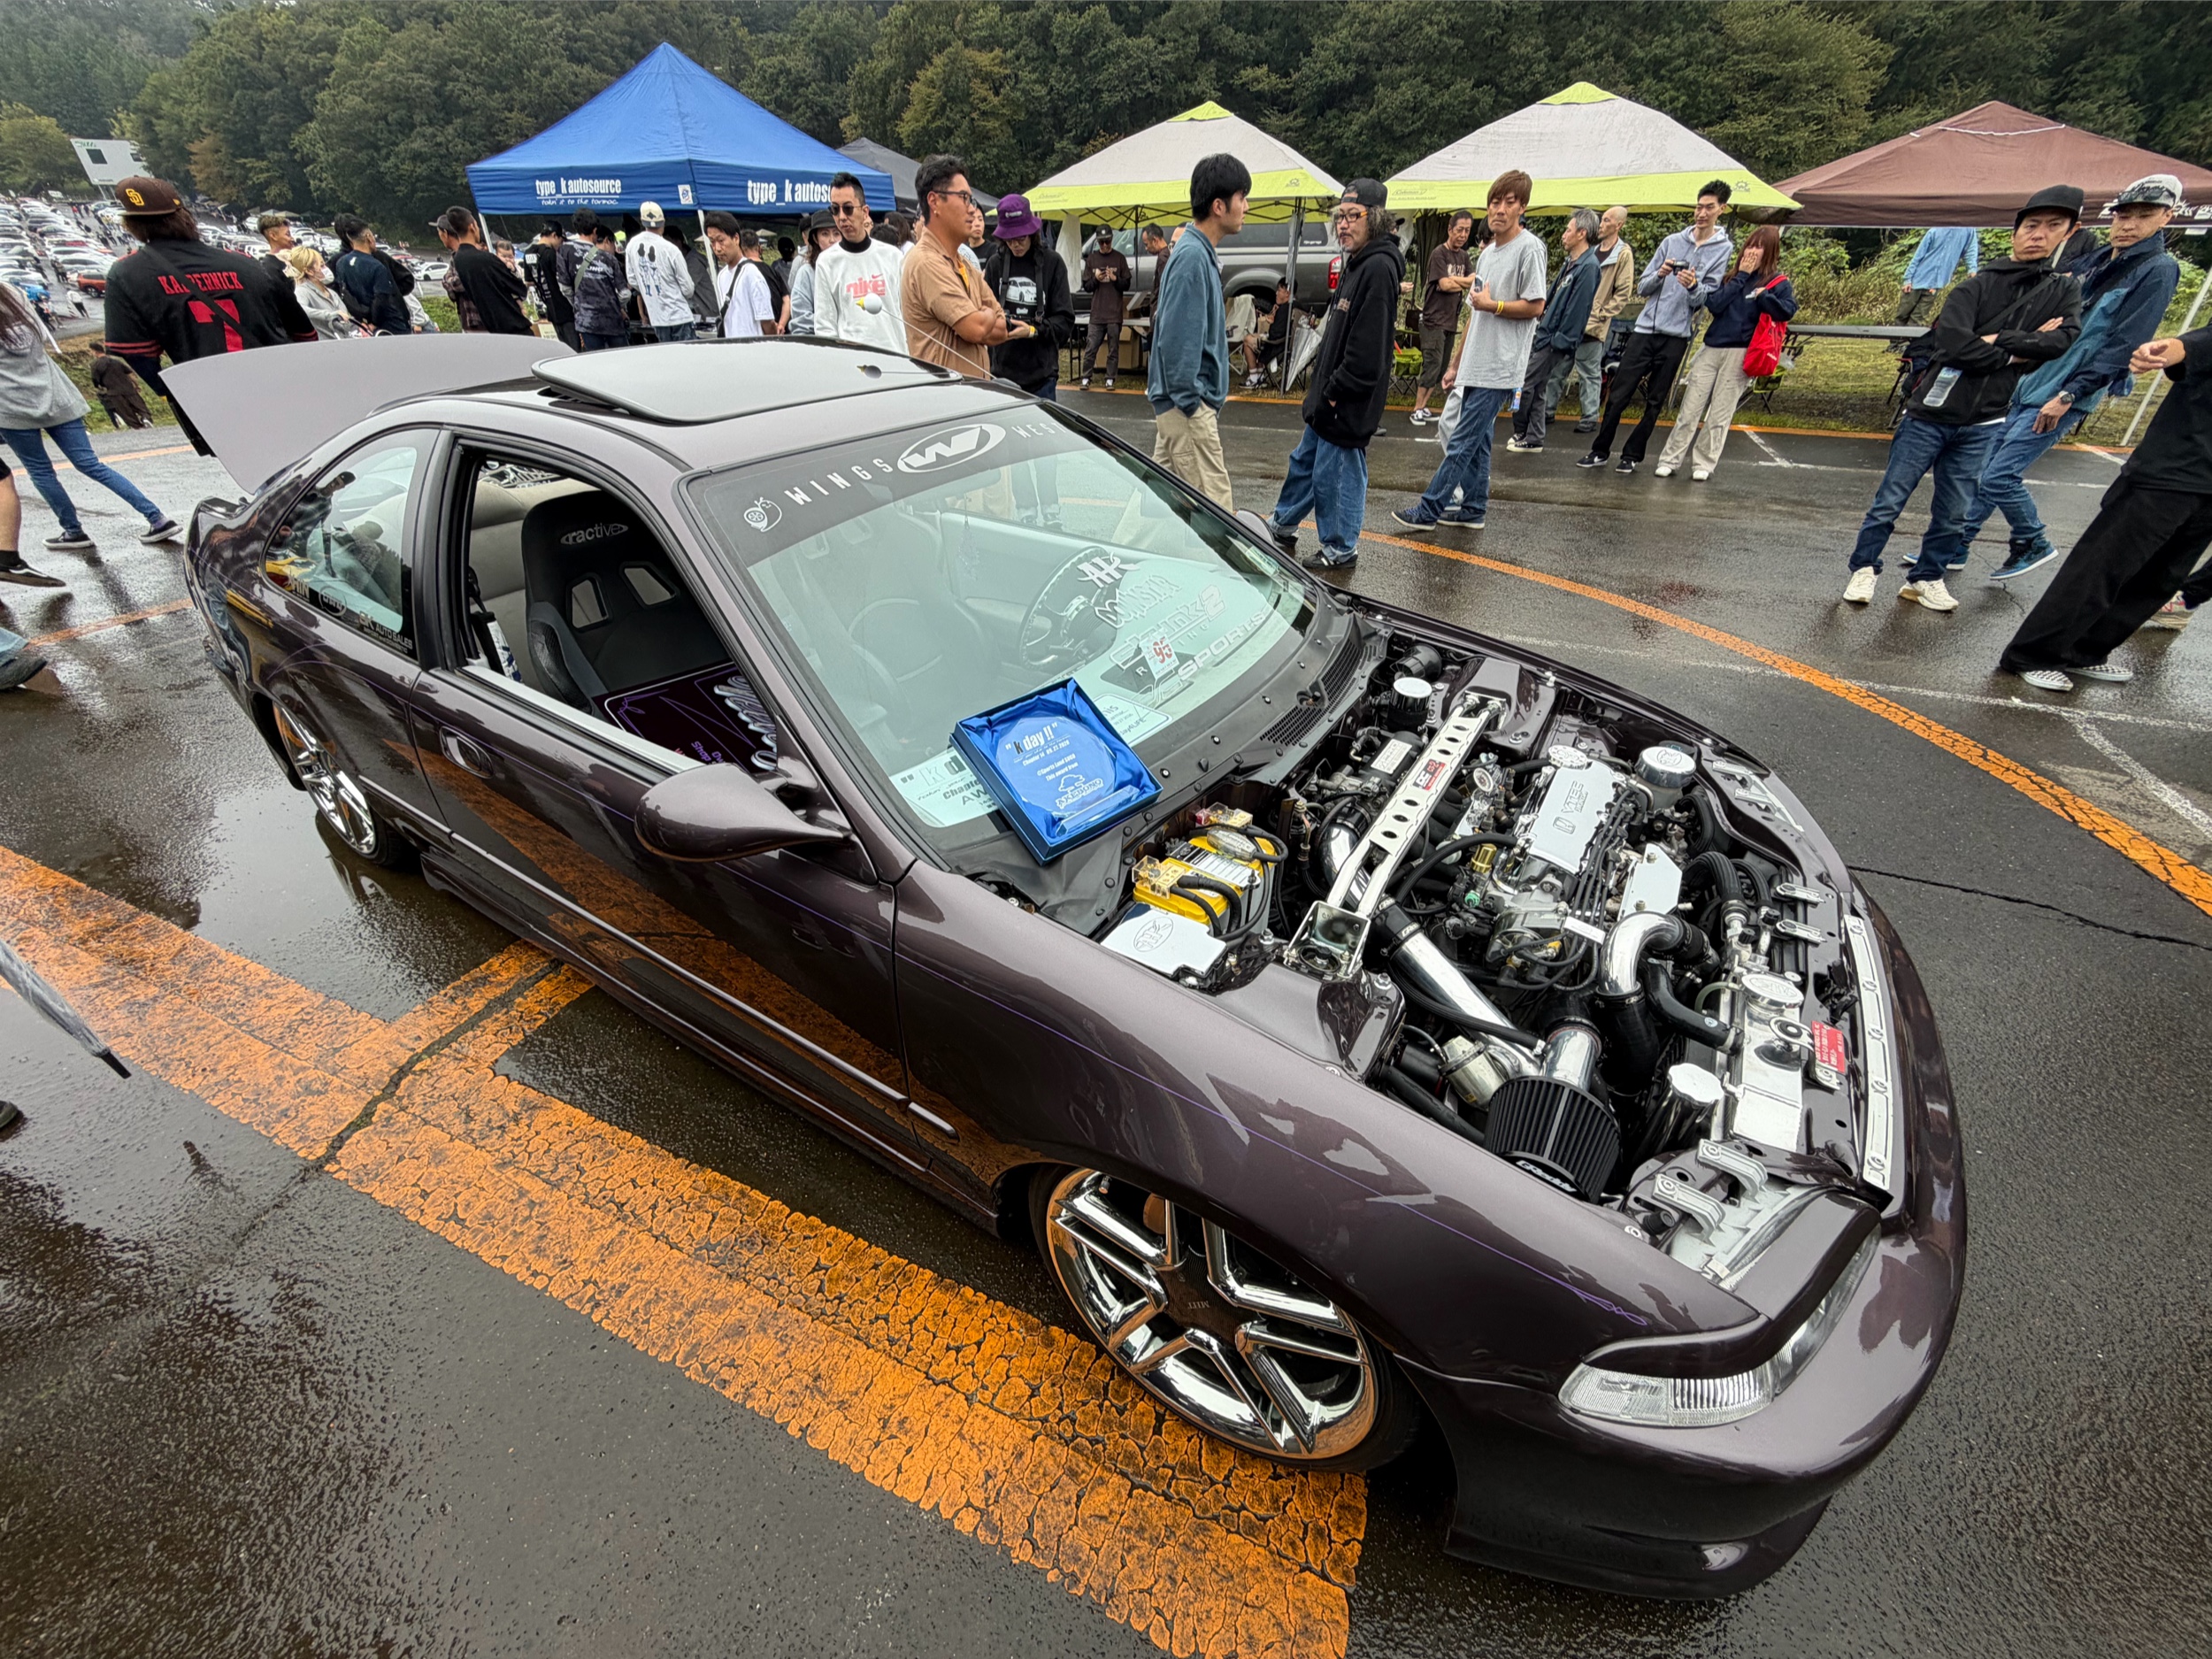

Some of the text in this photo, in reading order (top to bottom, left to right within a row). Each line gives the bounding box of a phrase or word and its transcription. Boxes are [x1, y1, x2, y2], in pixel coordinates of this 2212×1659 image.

[568, 178, 621, 194] autosource
[157, 272, 244, 295] KAERNICK
[784, 458, 894, 506] WINGS
[1011, 421, 1069, 439] WEST
[1178, 610, 1267, 681] SPORTS
[1022, 732, 1045, 751] day
[942, 779, 981, 800] Chapte
[1516, 1159, 1578, 1193] GReddy
